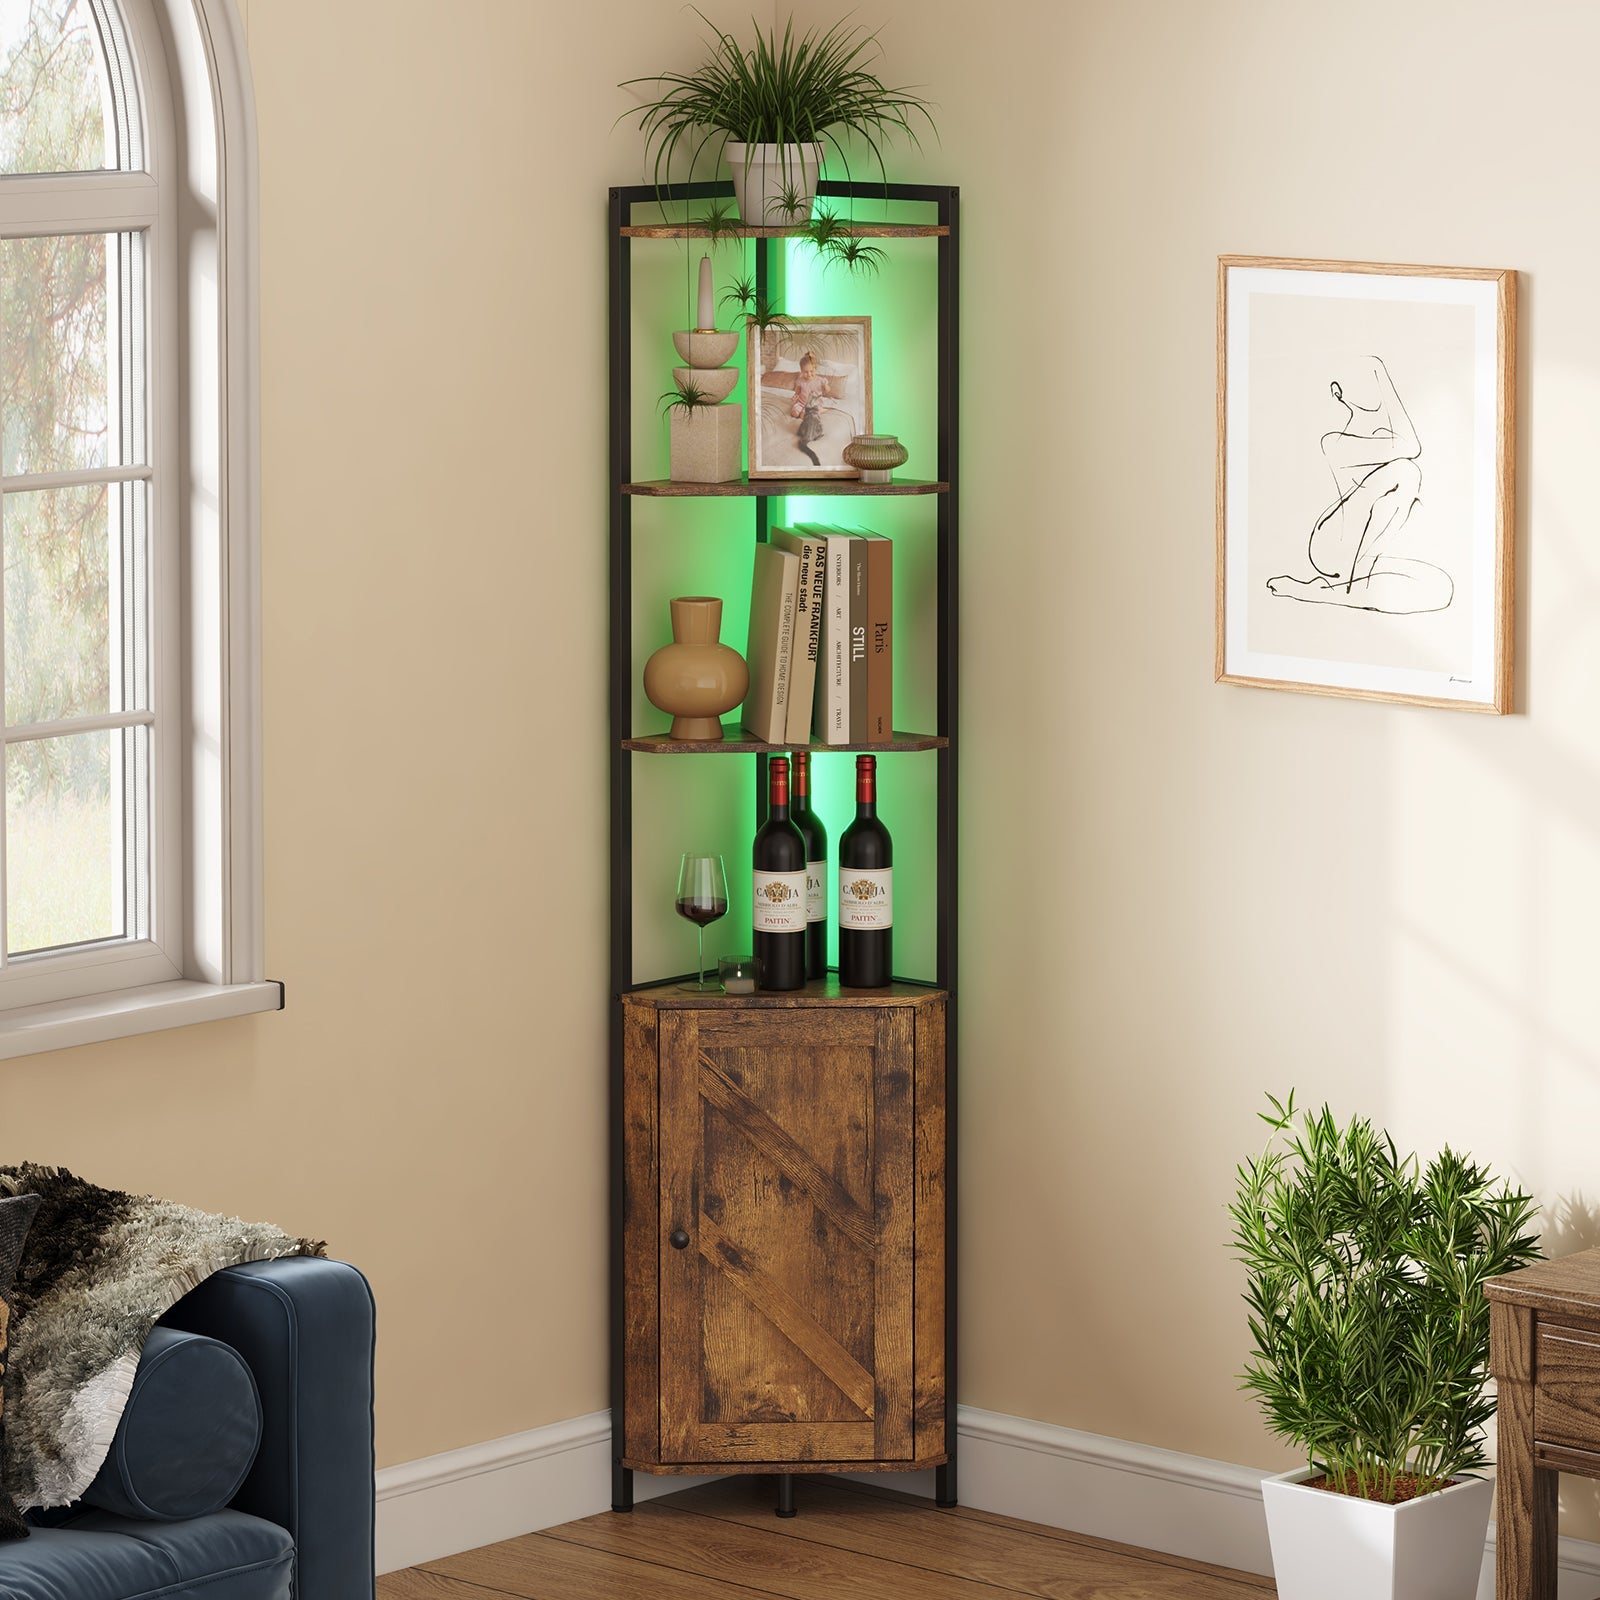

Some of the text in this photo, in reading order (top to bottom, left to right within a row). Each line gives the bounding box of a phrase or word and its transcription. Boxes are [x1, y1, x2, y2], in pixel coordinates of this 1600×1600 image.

[799, 545, 812, 613] die neue stadt
[808, 546, 825, 662] DAS NEUE FRANKFURT
[776, 592, 793, 705] THE COMPLETE GUIDE TO HOME DESIGN
[852, 626, 865, 662] STILL
[875, 622, 888, 654] Paris
